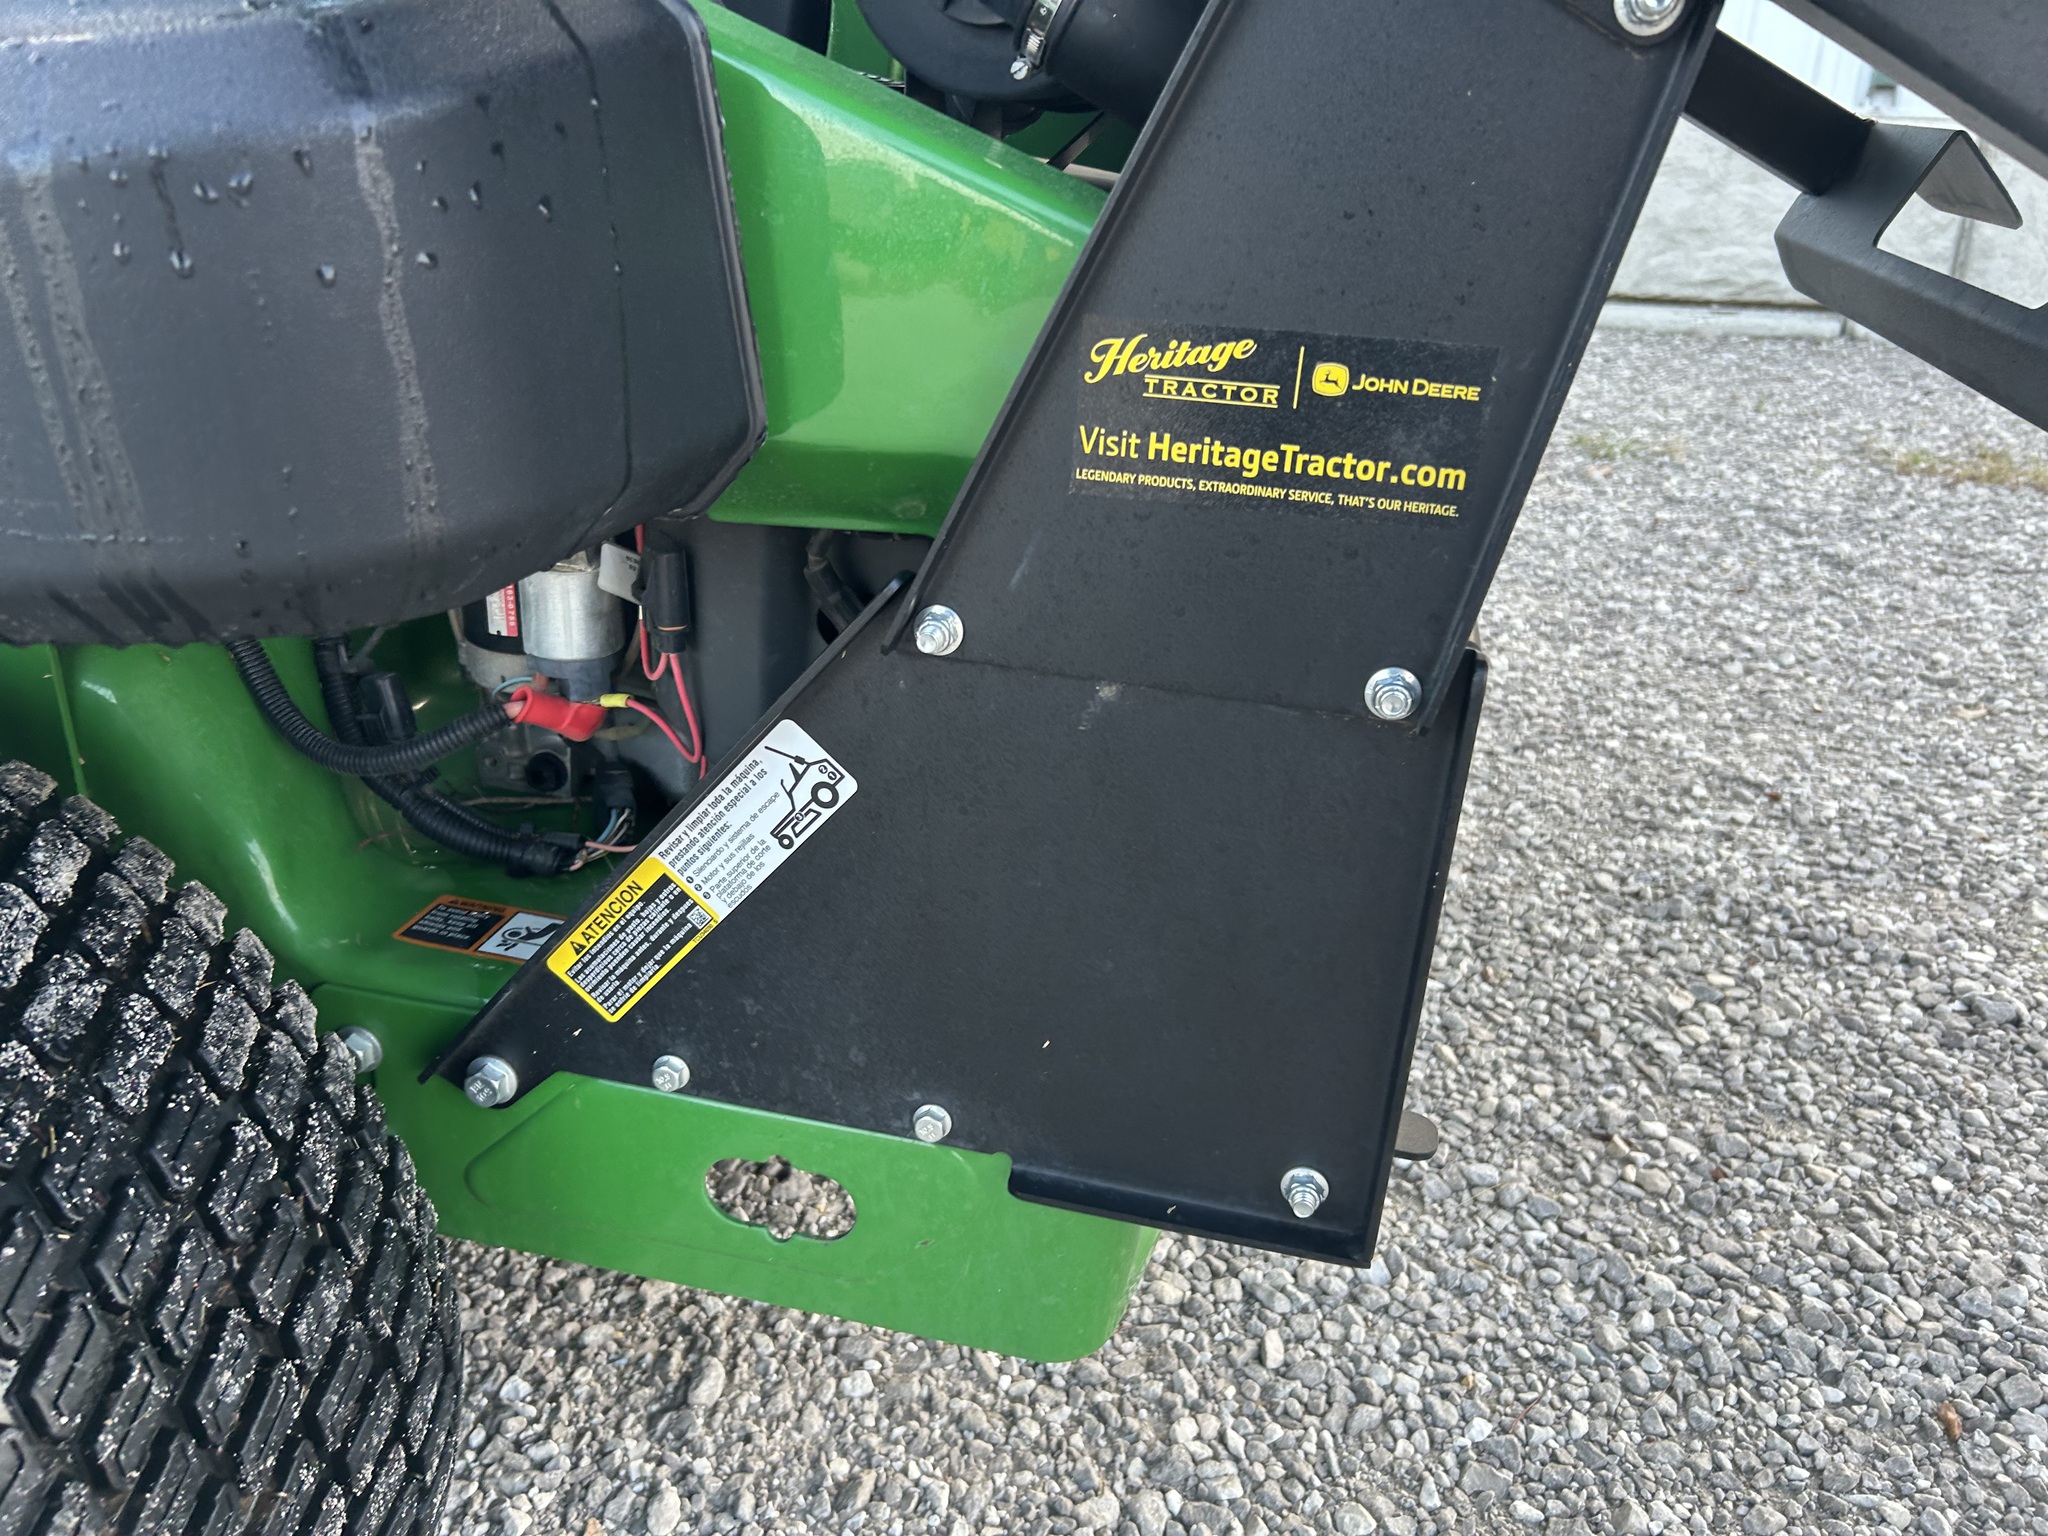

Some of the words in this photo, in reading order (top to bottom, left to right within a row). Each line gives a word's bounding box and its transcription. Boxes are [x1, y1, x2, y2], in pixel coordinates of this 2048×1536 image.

[1084, 334, 1257, 384] Heritage
[1143, 378, 1279, 404] TRACTOR
[1352, 374, 1409, 394] JOHN
[1412, 378, 1481, 401] DEERE
[1080, 427, 1139, 458] Visit
[1148, 433, 1466, 490] HeritageTractor.com
[1076, 470, 1139, 483] LEGENDARY
[1138, 475, 1194, 490] PRODUCTS,
[1198, 480, 1286, 498] EXTRAORDINARY
[1288, 490, 1334, 504] SERVICE,
[1377, 499, 1402, 511] OUR
[1403, 502, 1458, 516] HERITAGE.
[721, 786, 732, 795] la
[729, 759, 762, 790] máquina,
[668, 836, 699, 869] prestando
[697, 810, 725, 838] atención
[723, 782, 751, 812] especial
[753, 768, 767, 780] los
[684, 807, 710, 832] limpiar
[707, 793, 725, 809] toda
[722, 841, 729, 849] y
[727, 820, 751, 843] sistema
[750, 812, 758, 821] de
[757, 791, 780, 813] escape
[657, 834, 684, 859] Revisar
[676, 853, 699, 876] puntos
[696, 820, 732, 855] siguientes:
[681, 829, 689, 838] y
[700, 867, 719, 885] Motor
[718, 862, 725, 870] y
[723, 852, 736, 864] sus
[734, 833, 755, 853] rejillas
[708, 876, 727, 893] Parte
[726, 852, 750, 878] superior
[749, 845, 759, 854] de
[756, 838, 766, 846] la
[715, 867, 748, 899] plataforma
[746, 859, 755, 869] de
[754, 844, 771, 860] corte
[726, 878, 747, 899] debajo
[745, 870, 755, 879] de
[752, 861, 765, 871] los
[580, 879, 643, 944] ATENCION
[725, 884, 752, 908] escudos
[566, 961, 583, 977] Evitar
[580, 953, 591, 963] los
[612, 923, 621, 932] en
[619, 917, 626, 925] el
[574, 972, 585, 983] Las
[618, 931, 626, 940] de
[590, 979, 610, 998] Revisar
